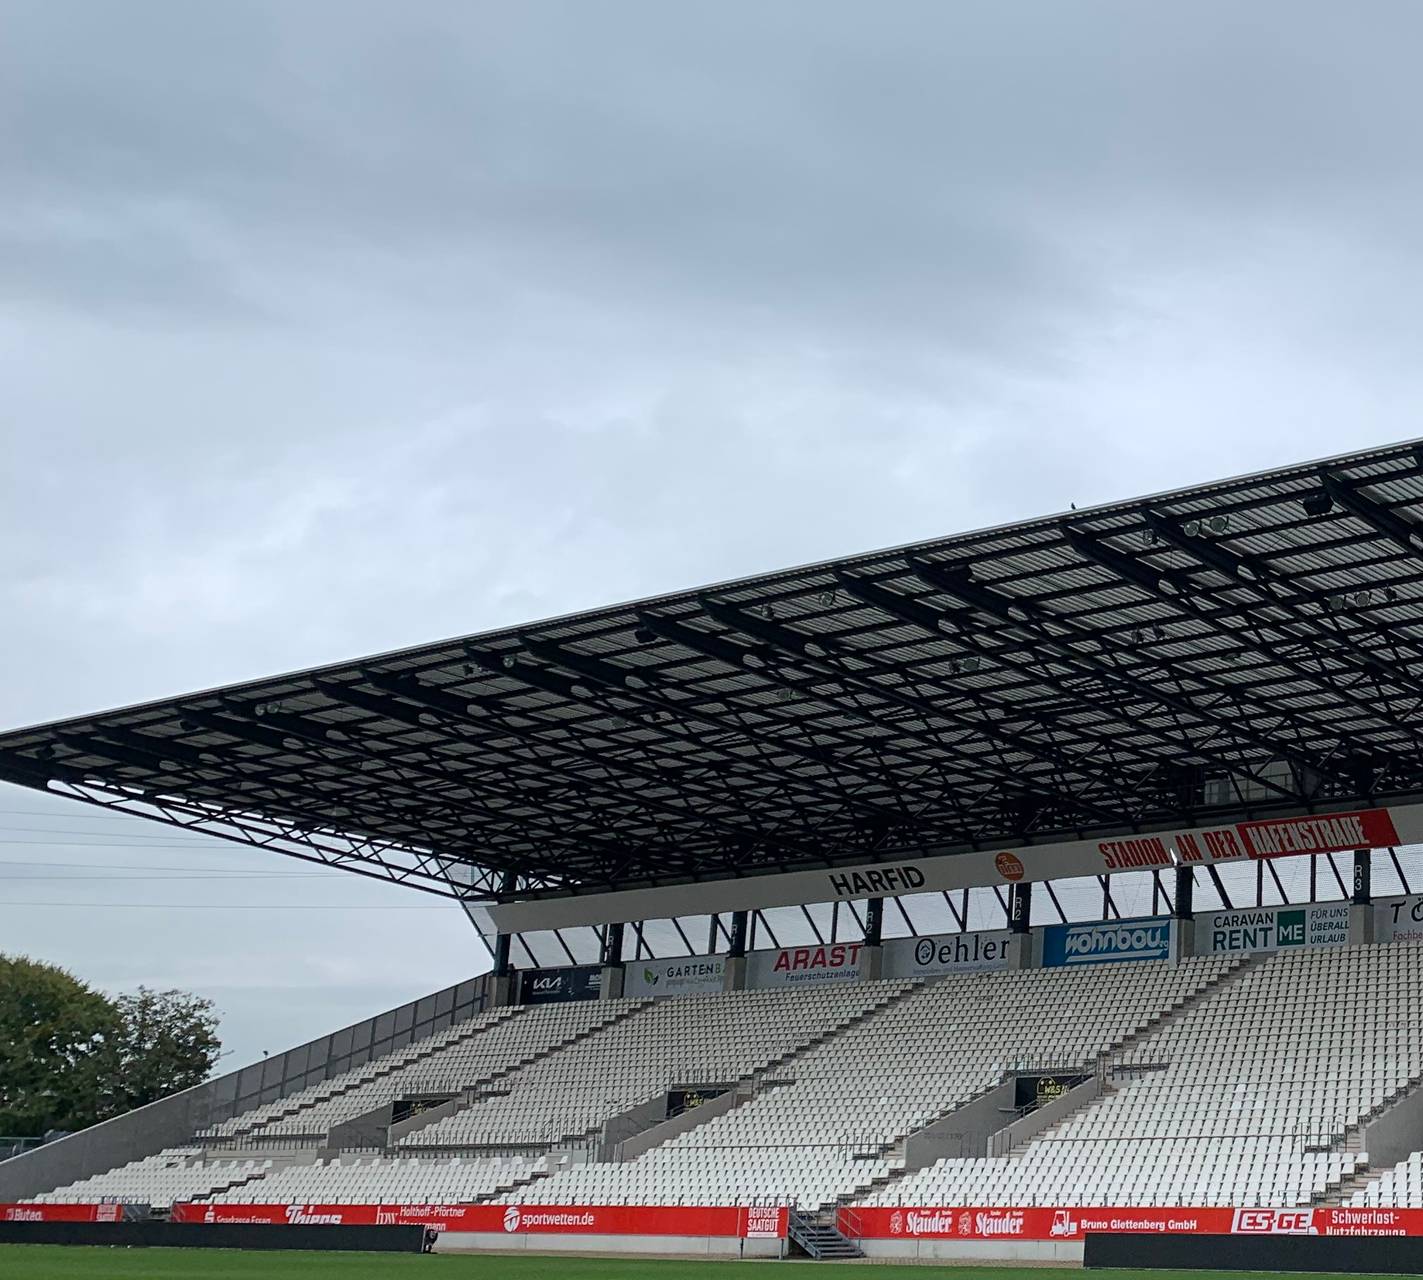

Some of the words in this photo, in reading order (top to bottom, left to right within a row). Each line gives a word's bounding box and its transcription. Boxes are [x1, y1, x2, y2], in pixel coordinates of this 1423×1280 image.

[1098, 838, 1171, 869] STADION
[1174, 833, 1203, 861] AN
[1203, 829, 1242, 860] DER
[829, 866, 925, 896] HARFID
[1213, 911, 1274, 929] CARAVAN
[1310, 908, 1328, 920] FÜR
[1329, 907, 1348, 919] UNS
[1310, 919, 1350, 932] ÜBERALL
[1213, 927, 1273, 951] RENT
[1279, 924, 1304, 942] ME
[1310, 932, 1347, 944] URLAUB
[914, 934, 1010, 966] Oehler
[773, 944, 864, 972] ARAST
[400, 1205, 465, 1218] Holthoff-Pförtner
[748, 1207, 780, 1219] DEUTSCHE
[1331, 1210, 1400, 1225] Schwerlast-
[521, 1212, 595, 1227] sportwetten.de
[747, 1218, 779, 1232] SAATGUT
[1081, 1219, 1108, 1230] Bruno
[1168, 1219, 1197, 1230] GmbH
